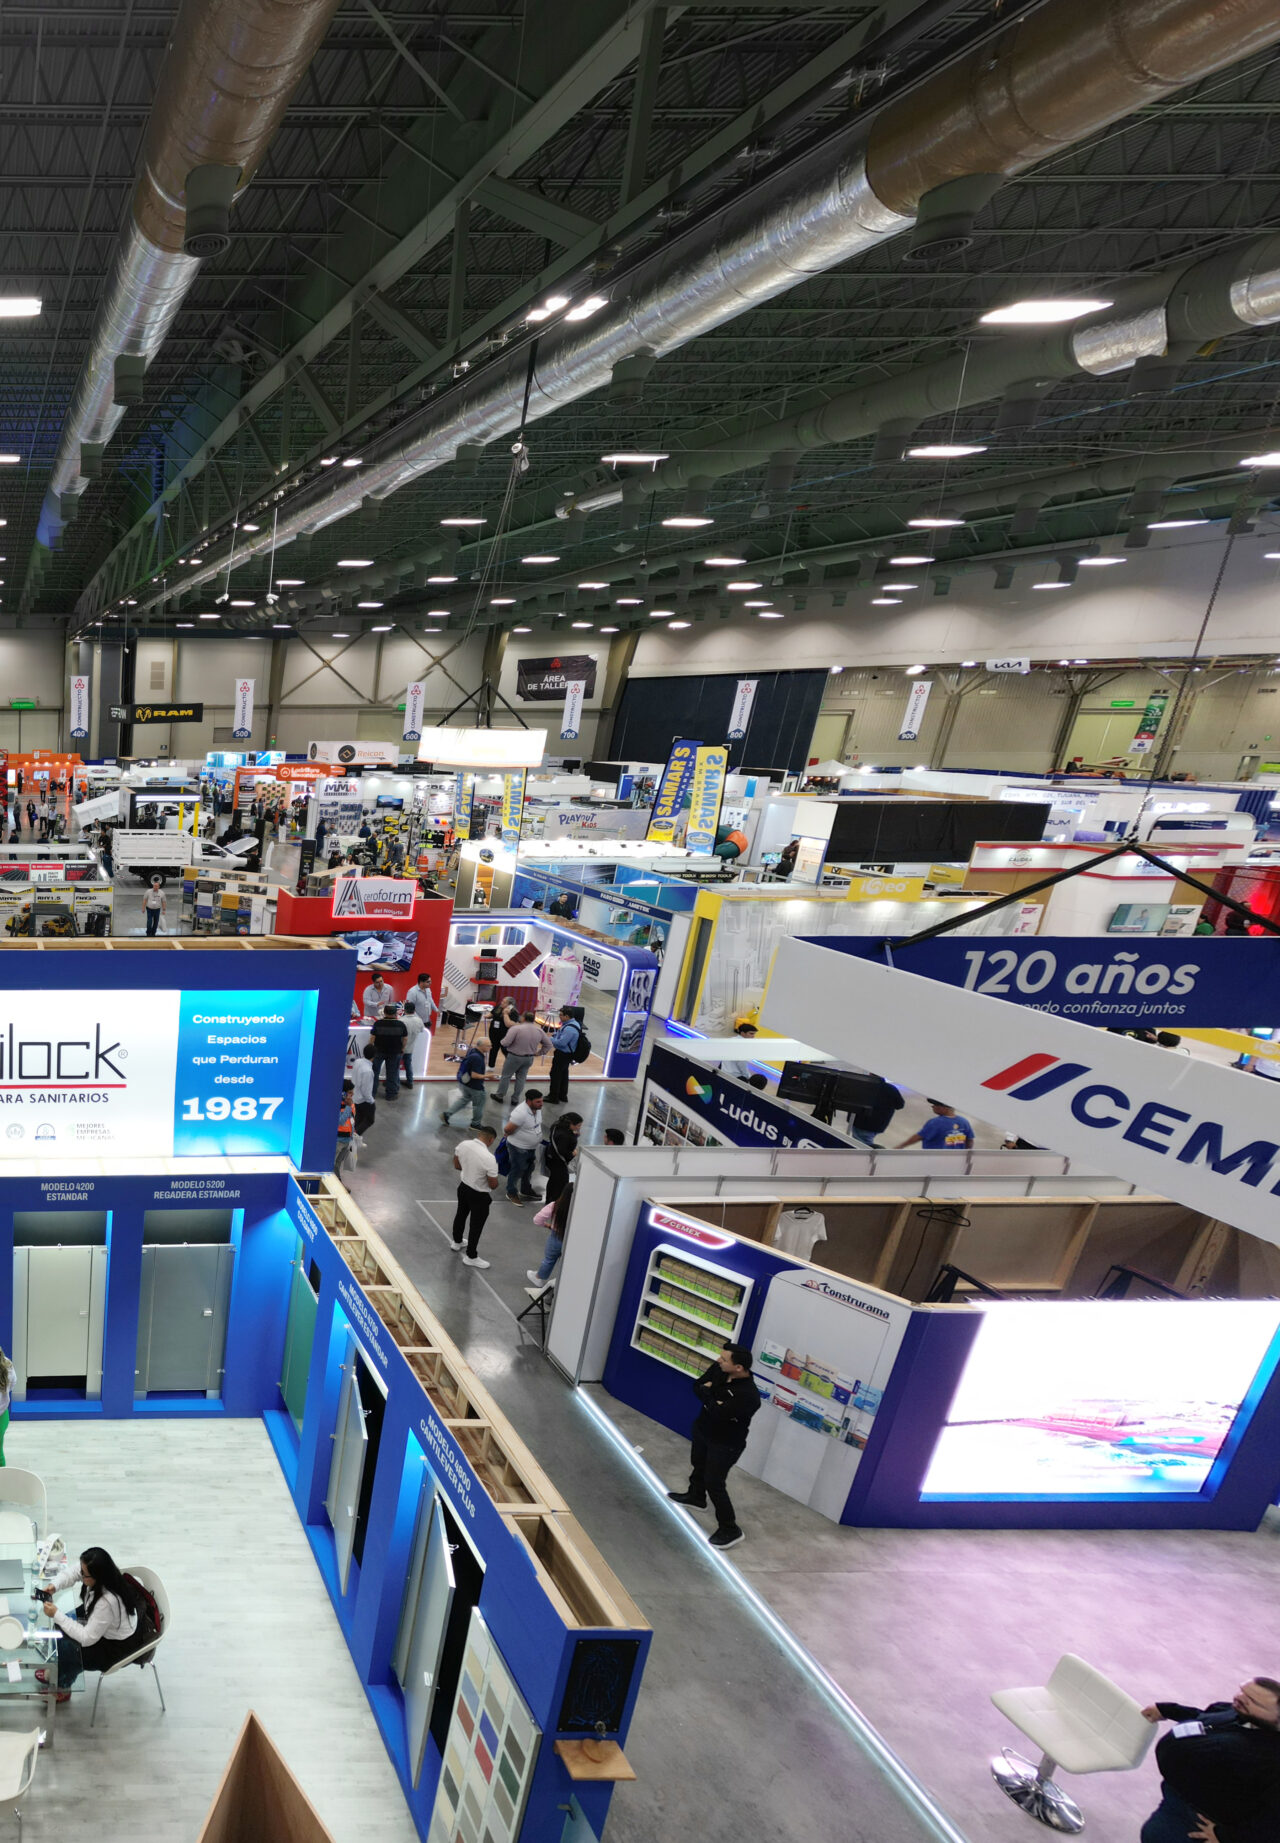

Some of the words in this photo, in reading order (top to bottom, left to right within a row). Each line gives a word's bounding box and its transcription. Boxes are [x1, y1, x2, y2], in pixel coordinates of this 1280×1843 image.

[542, 674, 566, 683] ÁREA
[527, 683, 538, 691] DE
[539, 681, 570, 690] TALLER
[153, 709, 193, 717] RAM
[72, 730, 85, 738] 400
[235, 730, 249, 738] 500
[405, 733, 419, 741] 600
[562, 731, 576, 739] 700
[730, 731, 743, 739] 800
[901, 732, 915, 740] 900
[582, 955, 601, 970] FARO
[963, 950, 1057, 994] 120
[1065, 952, 1202, 995] años
[1062, 1000, 1138, 1015] confianza
[1135, 1001, 1186, 1017] juntos
[192, 1015, 285, 1026] Construyendo
[207, 1035, 267, 1046] Espacios
[192, 1056, 216, 1066] que
[220, 1055, 279, 1065] Perduran
[214, 1074, 254, 1085] desde
[29, 1093, 110, 1104] SANITARIOS
[182, 1097, 284, 1121] 1987
[719, 1093, 779, 1142] Ludus
[1071, 1084, 1280, 1197] CEM
[41, 1182, 75, 1192] MODELO
[75, 1182, 95, 1191] 4200
[171, 1180, 205, 1189] MODELO
[205, 1180, 225, 1189] 5200
[46, 1192, 88, 1201] ESTANDAR
[154, 1190, 197, 1200] REGADERA
[198, 1190, 241, 1199] ESTANDAR
[669, 1220, 702, 1238] CEMEX
[349, 1283, 368, 1319] MODELO
[822, 1283, 890, 1320] Construrama
[338, 1280, 365, 1328] CANTILEVER
[362, 1321, 389, 1369] ESTANDAR
[428, 1414, 455, 1463] MODELO
[420, 1419, 458, 1489] CANTILEVER
[457, 1482, 476, 1518] PLUS
